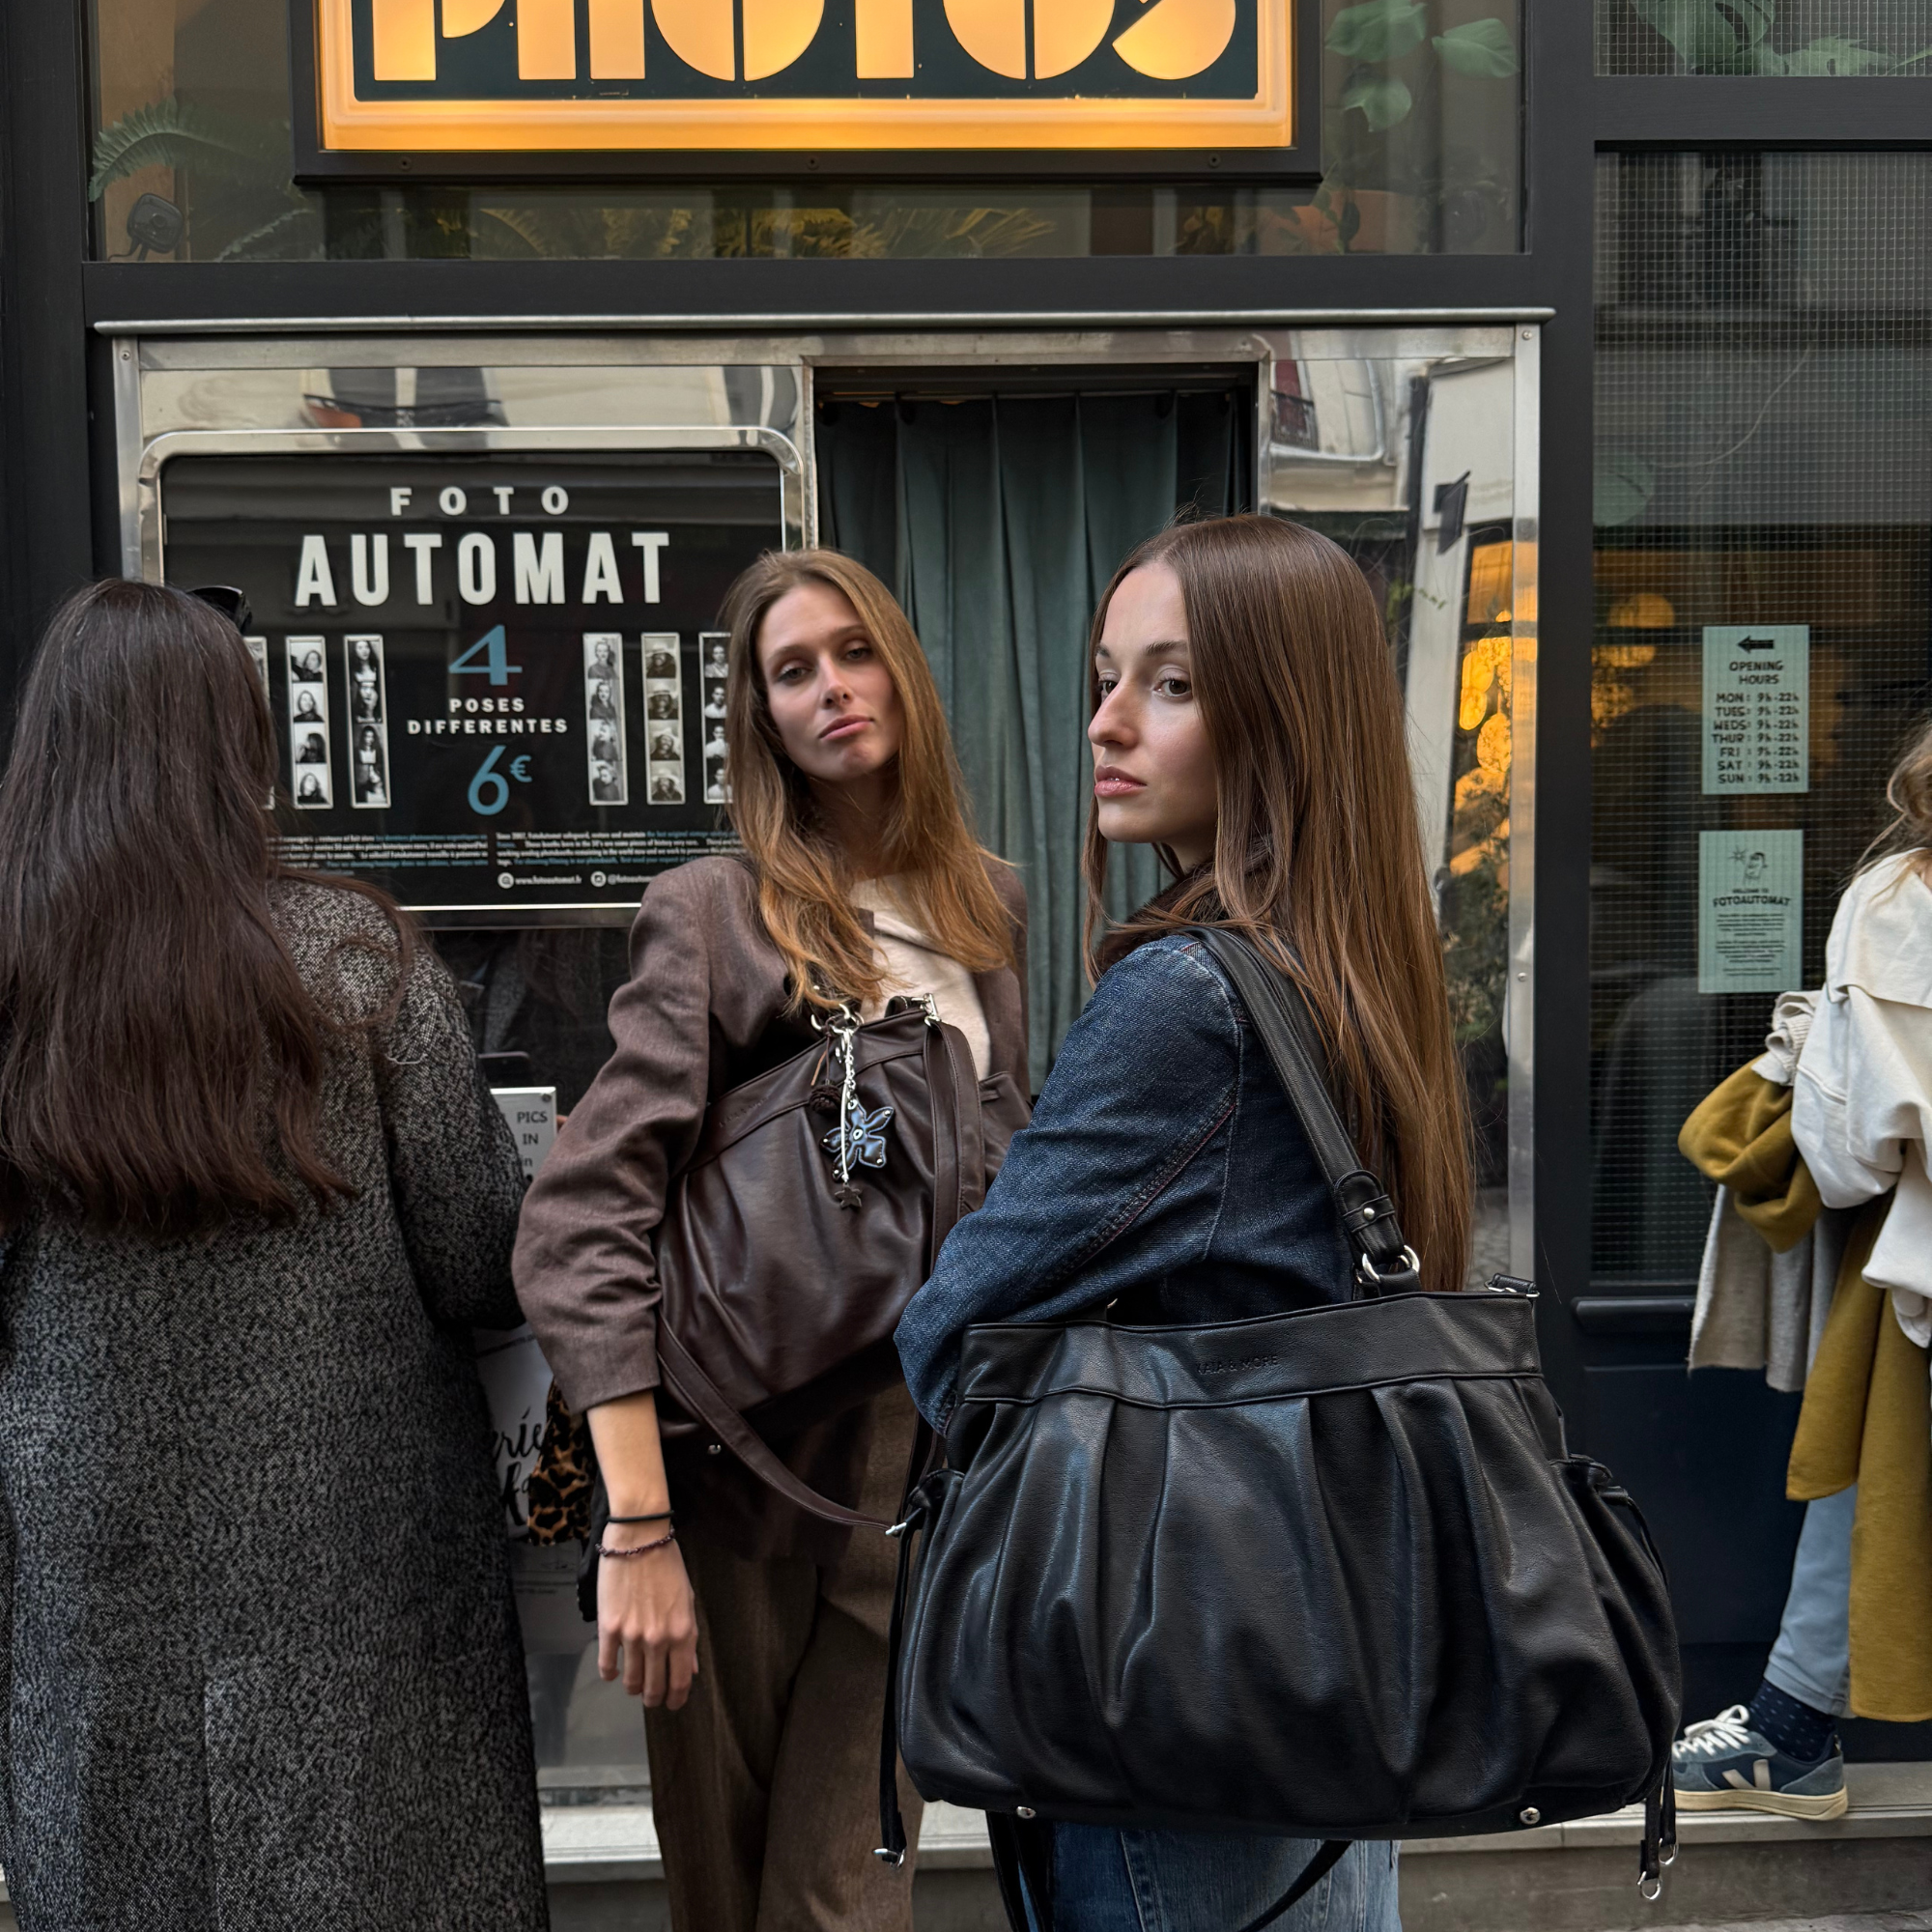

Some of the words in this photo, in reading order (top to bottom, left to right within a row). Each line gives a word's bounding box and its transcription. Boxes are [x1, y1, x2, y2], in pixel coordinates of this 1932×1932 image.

[390, 486, 570, 516] FOTO
[295, 532, 669, 607] AUTOMAT
[448, 625, 523, 686] 4
[1729, 661, 1783, 671] OPENING
[1739, 674, 1779, 685] HOURS
[449, 697, 525, 713] POSES
[408, 719, 567, 734] DIFFERENTES
[469, 745, 533, 815] 6€
[1713, 895, 1791, 908] FOTOAUTOMAT
[516, 1110, 549, 1124] PICS
[522, 1132, 539, 1146] IN
